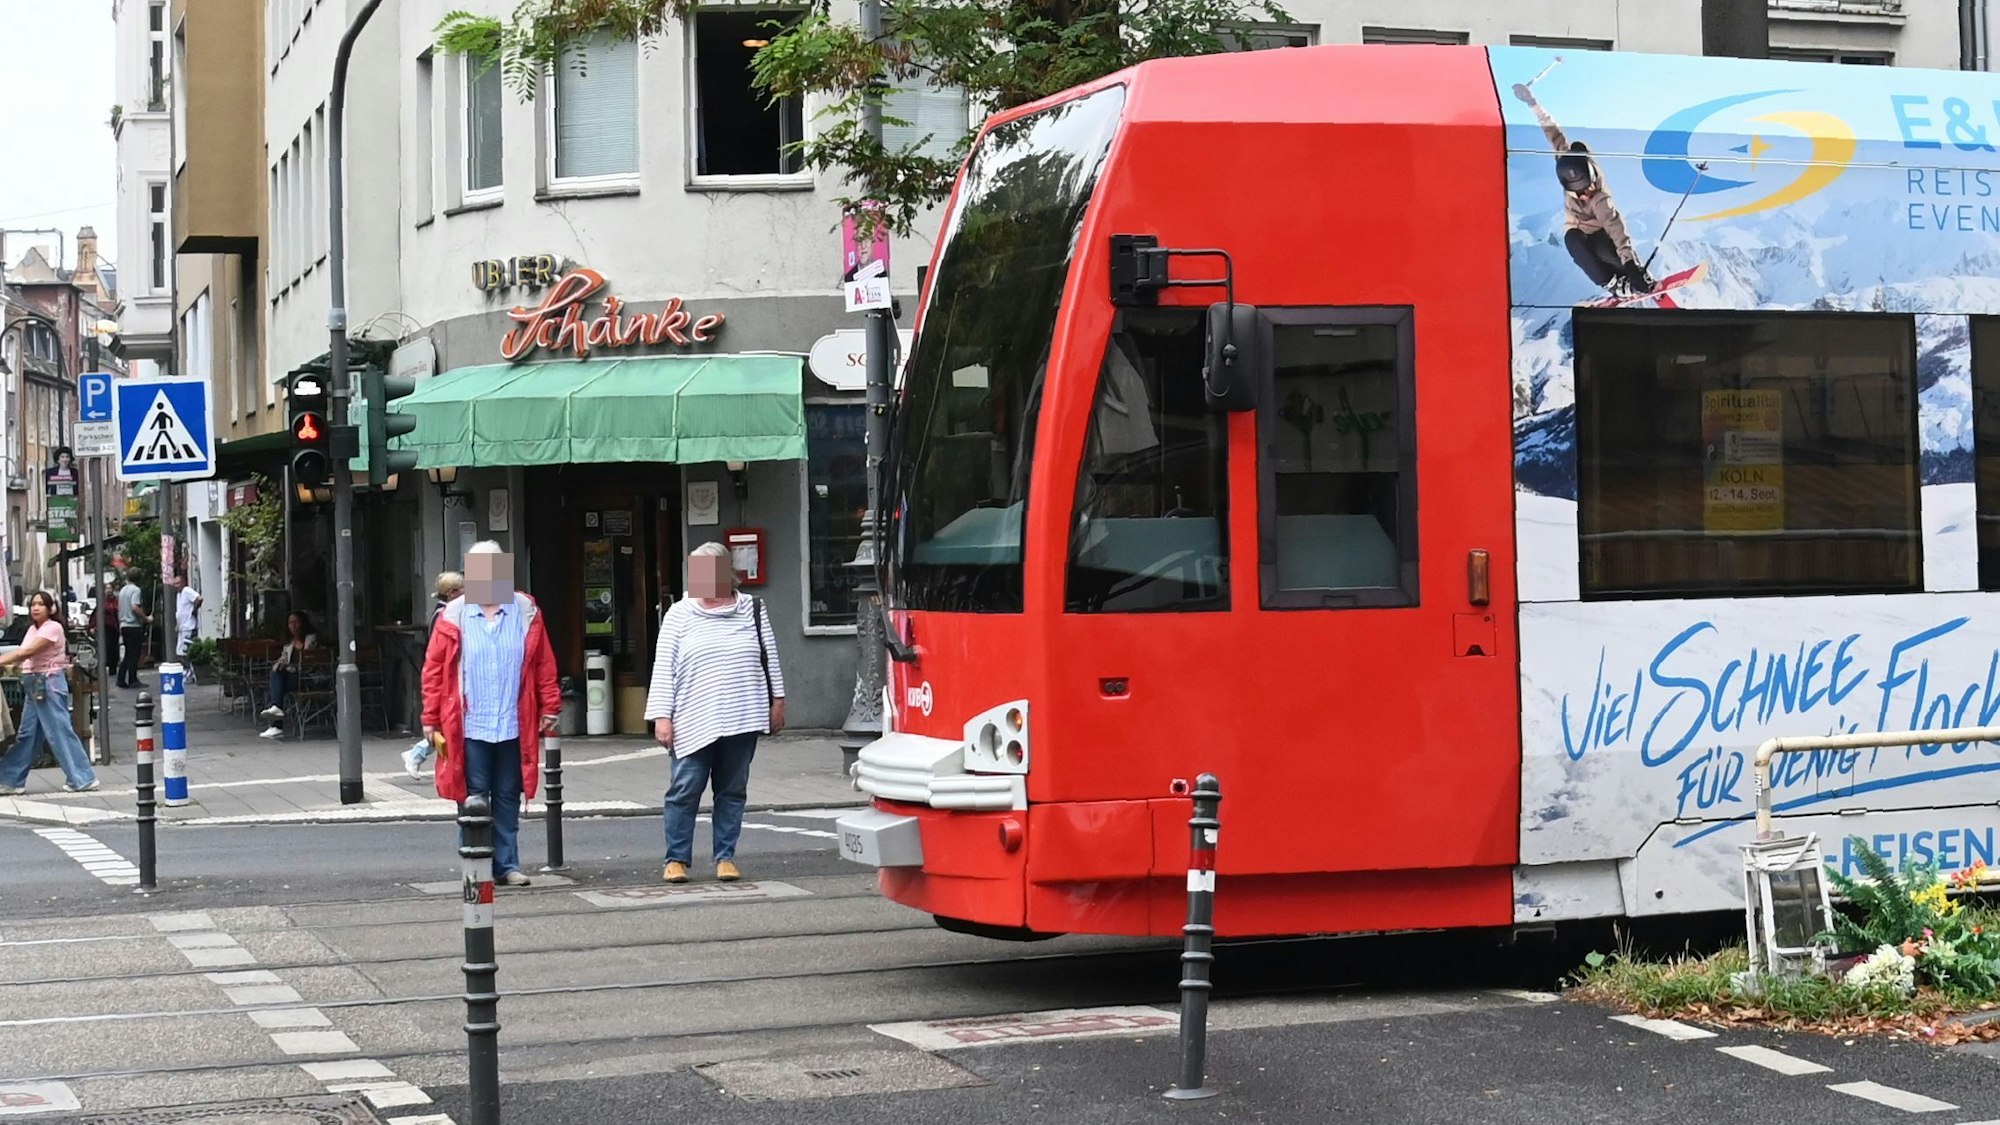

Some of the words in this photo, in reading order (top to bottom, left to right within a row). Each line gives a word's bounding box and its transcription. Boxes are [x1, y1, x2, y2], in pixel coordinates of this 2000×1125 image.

[1891, 95, 2000, 152] E&
[1907, 169, 1991, 197] REIS
[1908, 203, 1999, 232] EVEN
[472, 253, 557, 290] UBIER
[500, 268, 726, 362] Schänke
[86, 379, 105, 407] P
[1676, 745, 1742, 817] FÜR
